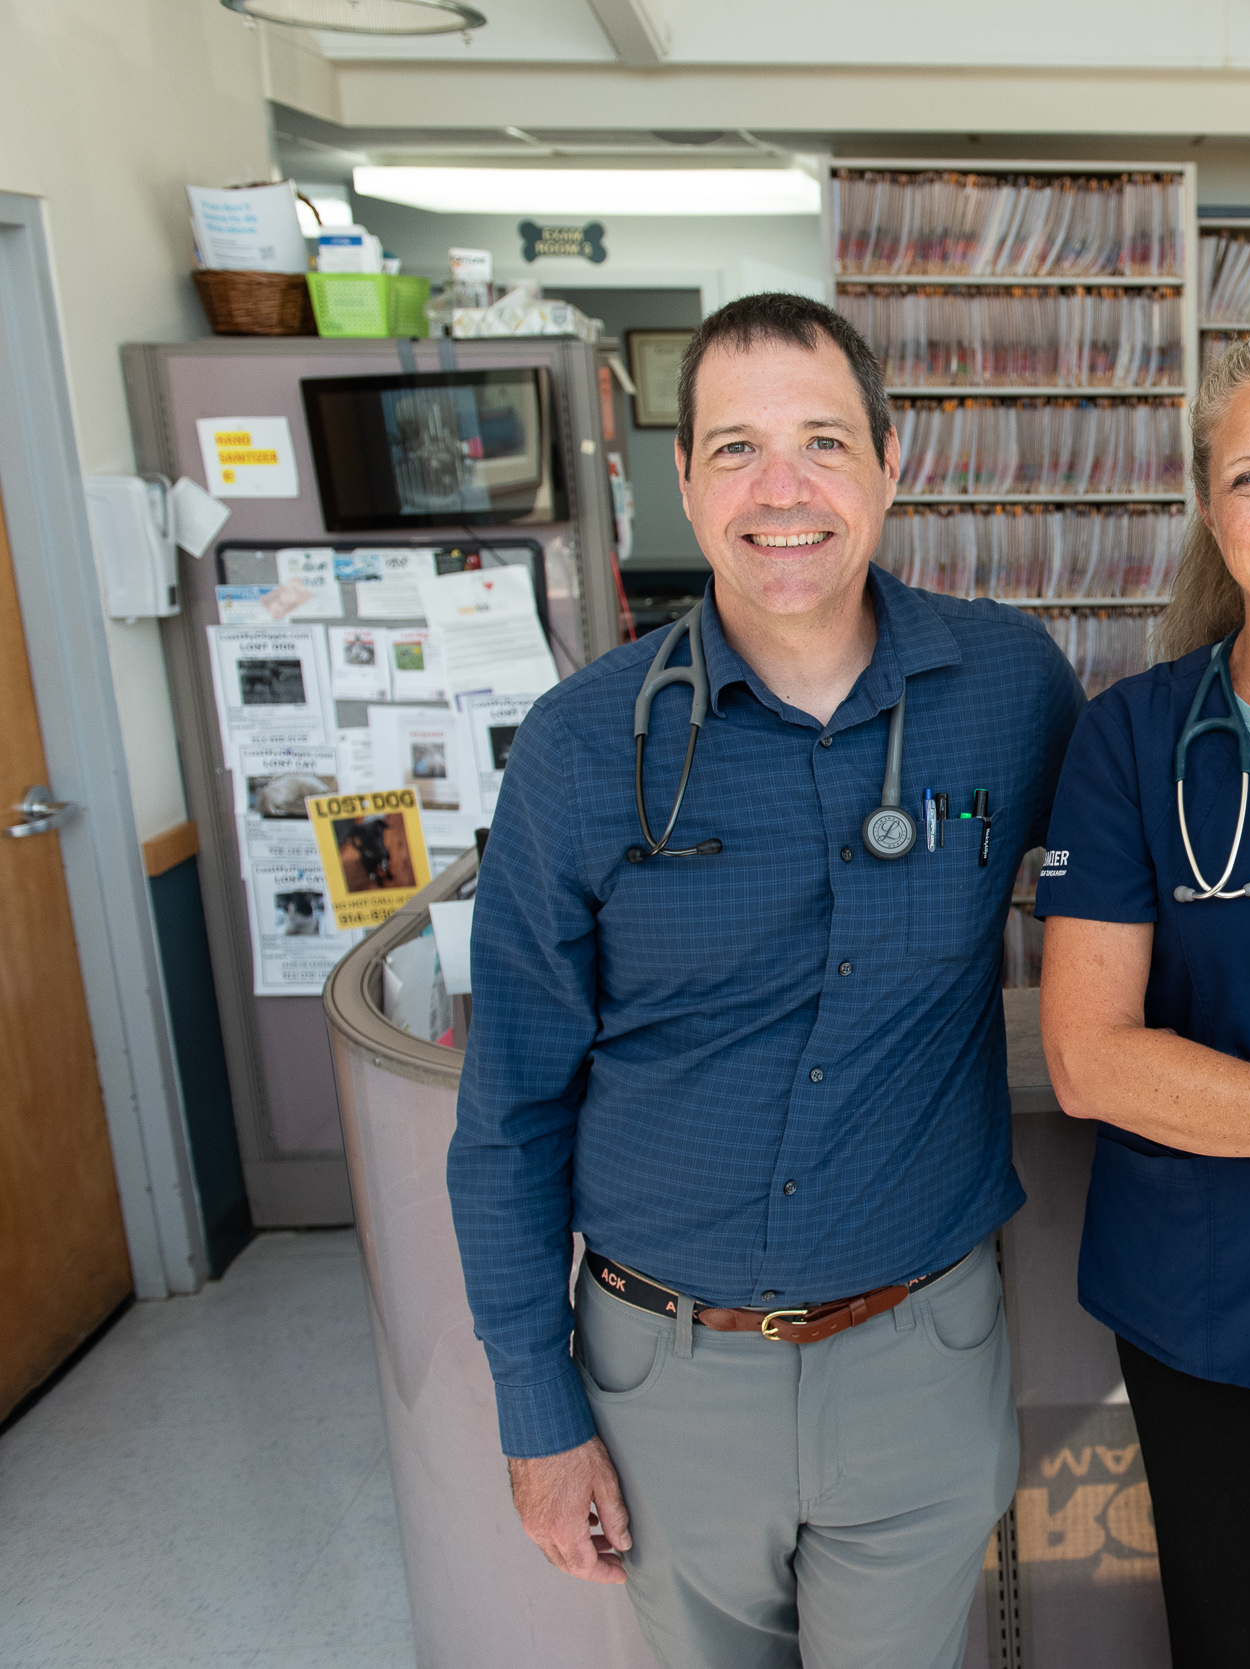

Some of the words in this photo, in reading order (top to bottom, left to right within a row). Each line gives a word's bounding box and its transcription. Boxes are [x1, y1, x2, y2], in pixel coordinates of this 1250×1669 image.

[542, 228, 583, 240] EXAM
[534, 240, 580, 255] ROOM
[215, 435, 250, 446] HAND
[219, 452, 278, 464] SANITIZER
[315, 795, 366, 818] LOST
[372, 789, 415, 811] DOG
[601, 1268, 626, 1292] ACK
